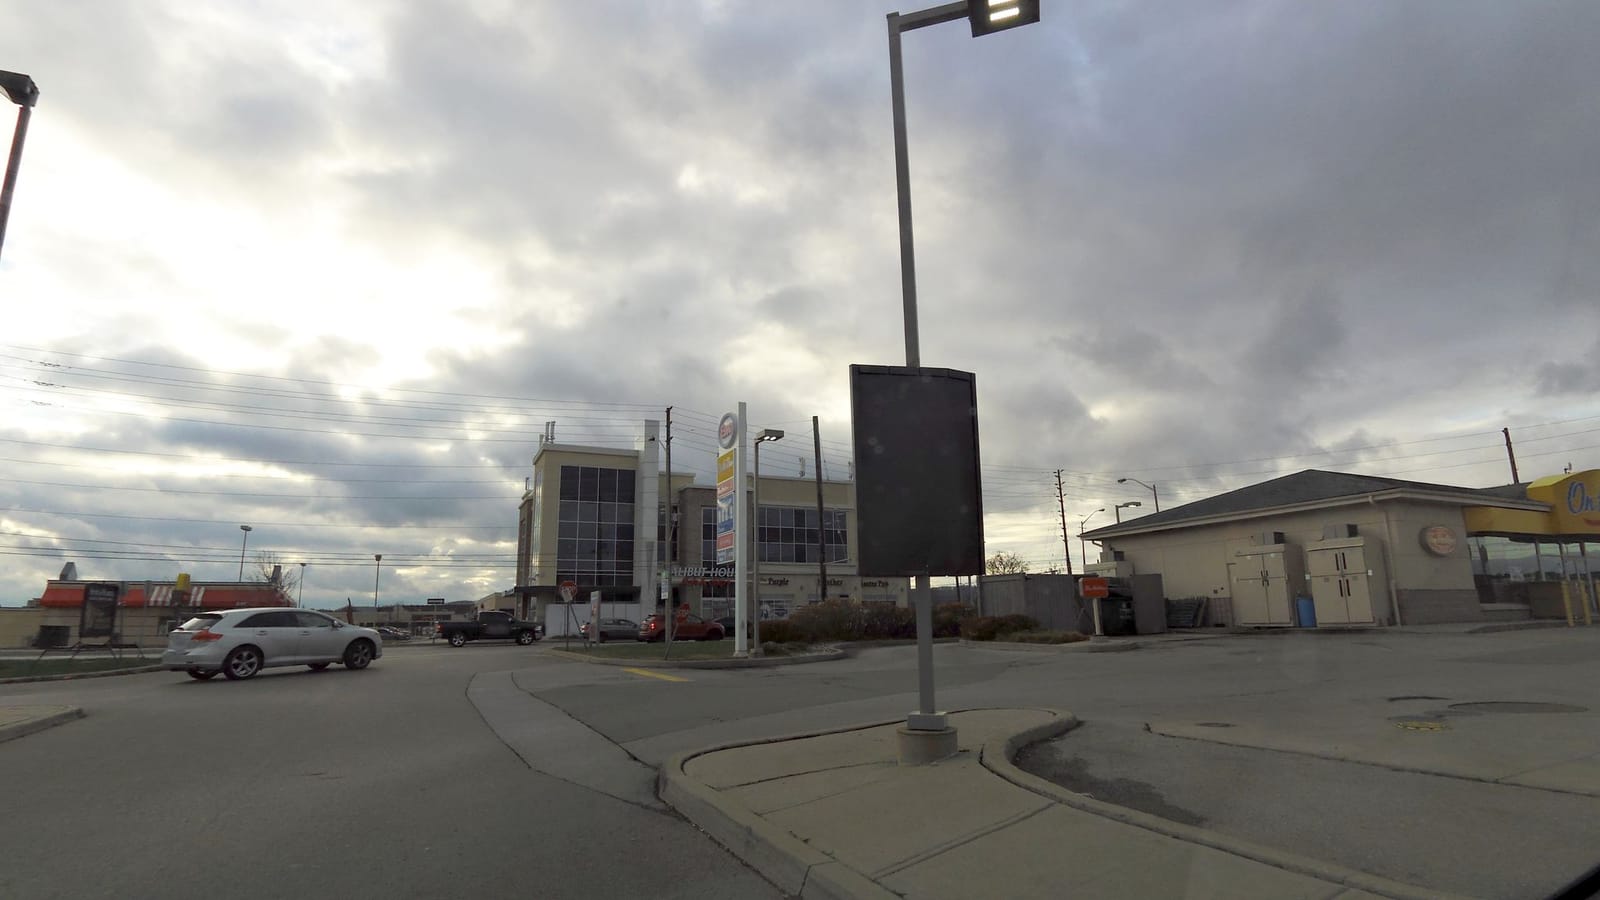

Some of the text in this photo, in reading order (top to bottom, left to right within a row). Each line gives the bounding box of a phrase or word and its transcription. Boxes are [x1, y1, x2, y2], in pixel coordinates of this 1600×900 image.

[671, 567, 735, 577] ALIBUT HOU
[768, 577, 789, 587] Purple
